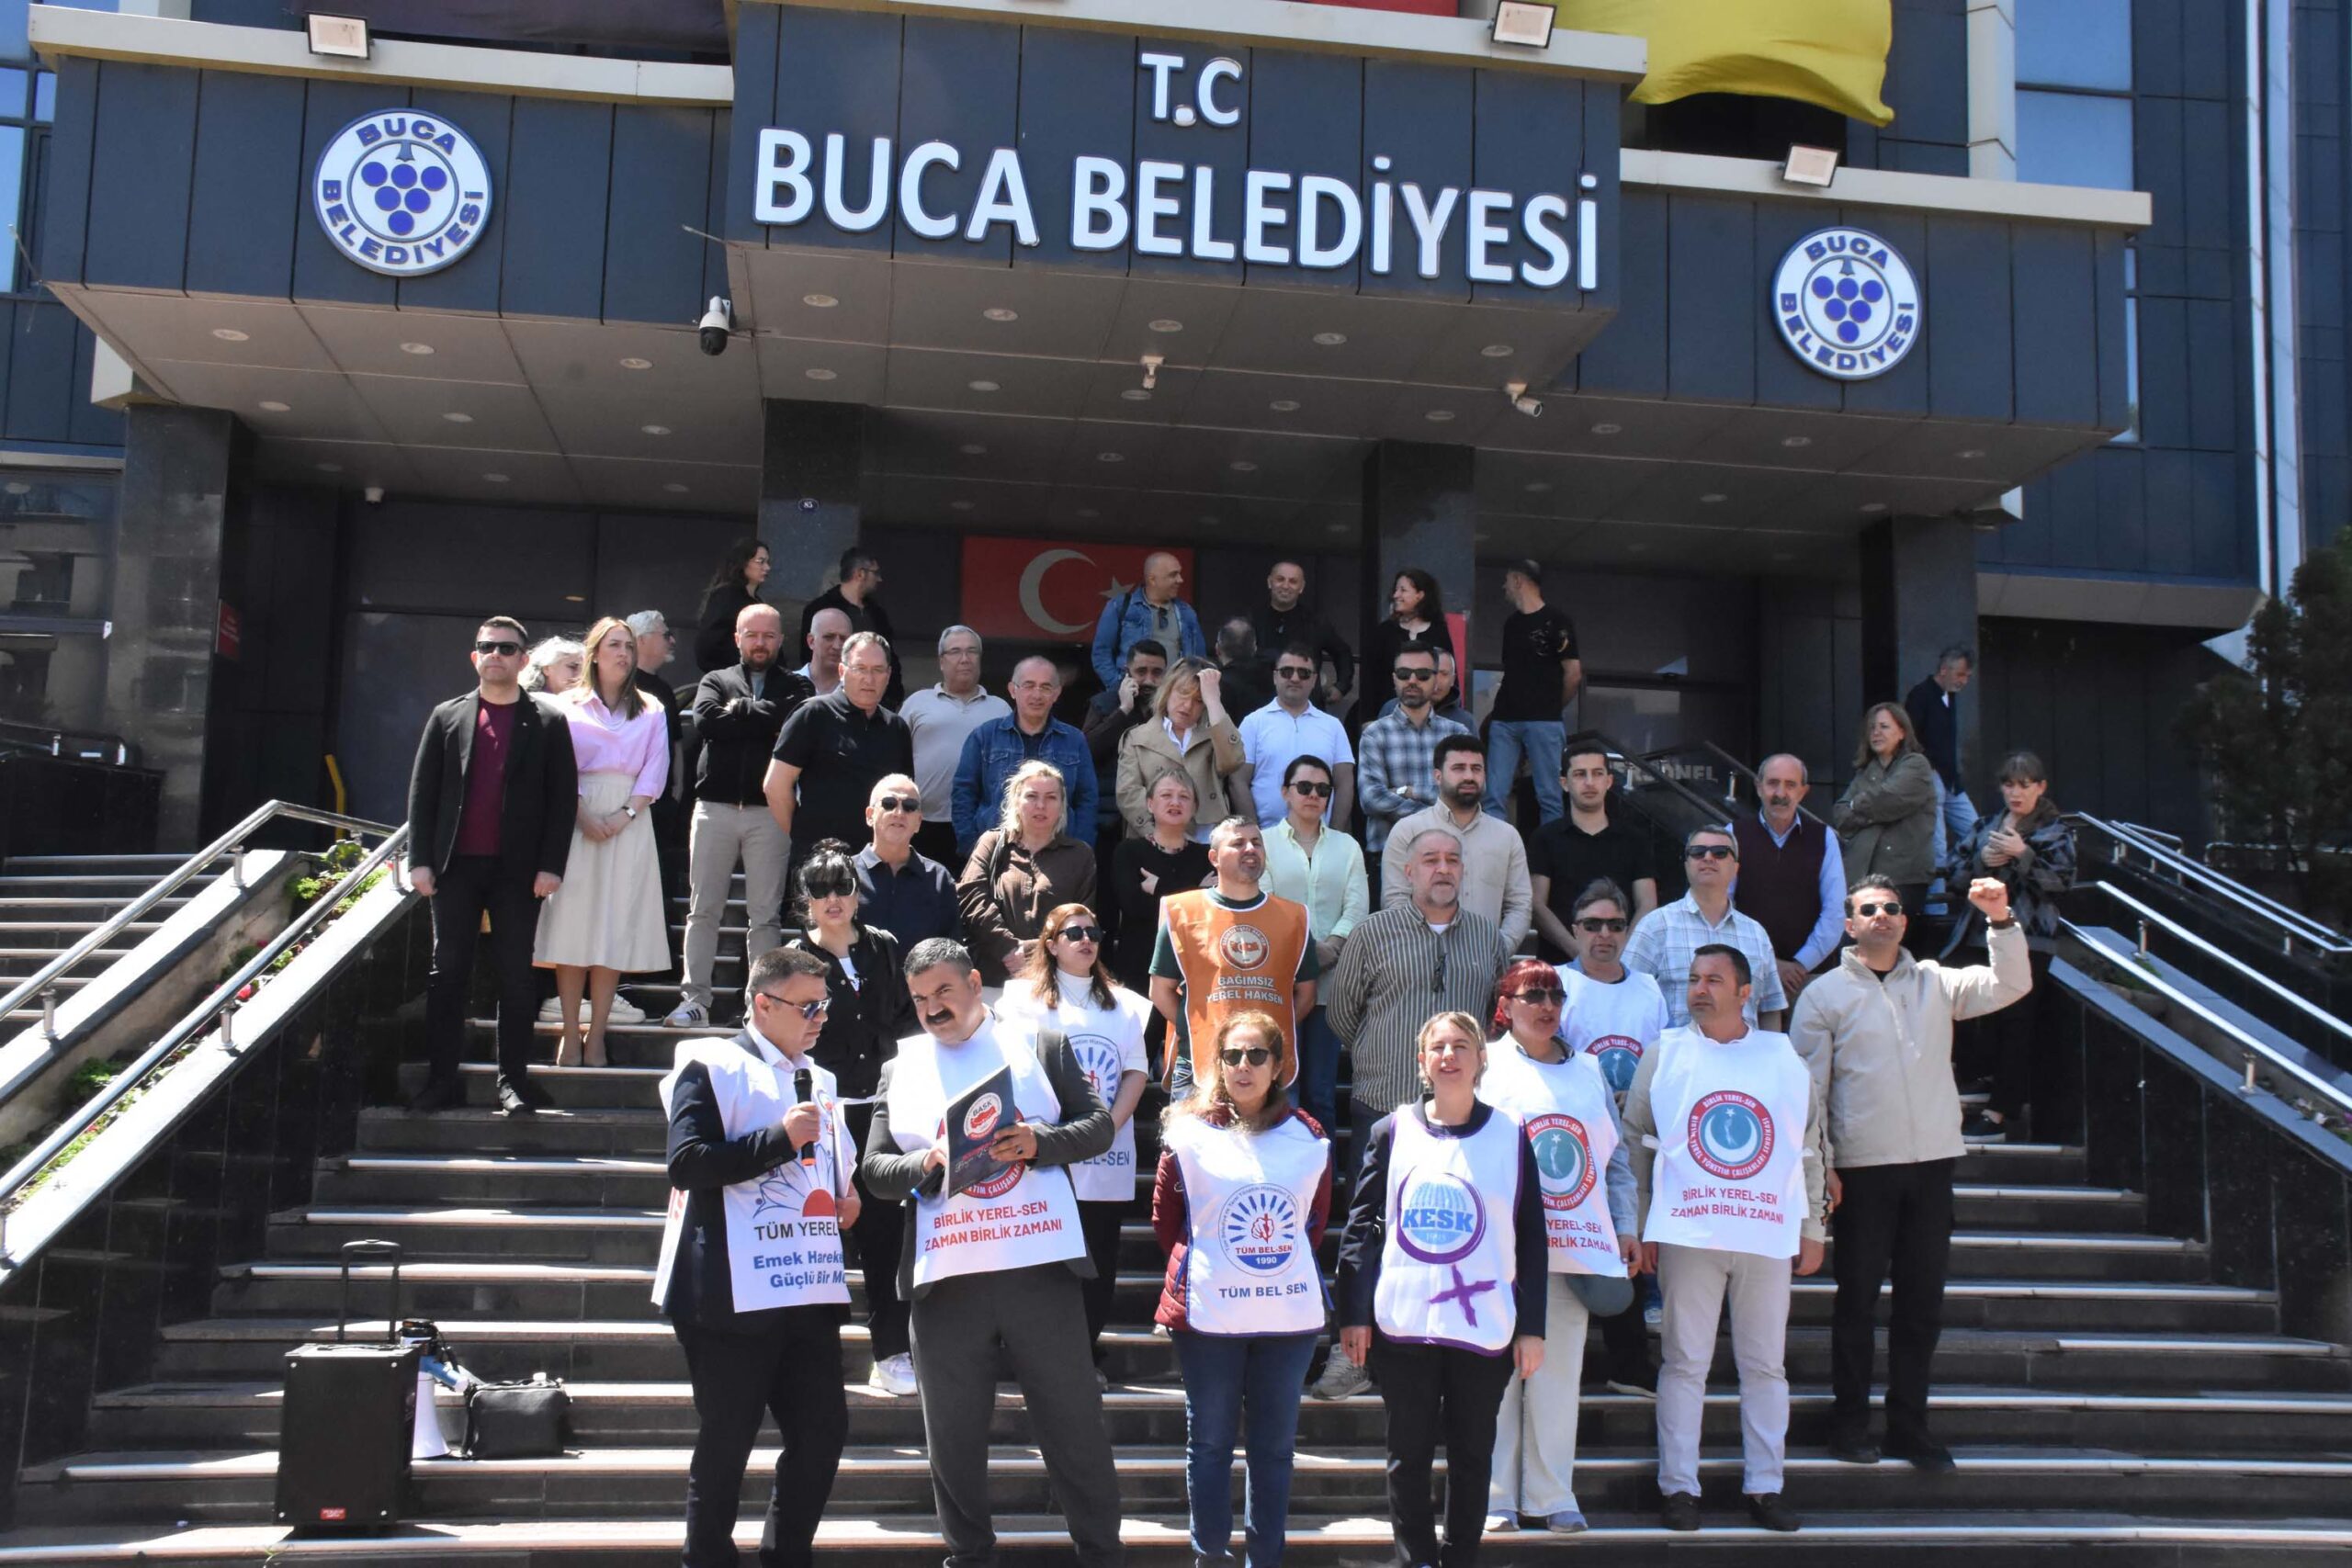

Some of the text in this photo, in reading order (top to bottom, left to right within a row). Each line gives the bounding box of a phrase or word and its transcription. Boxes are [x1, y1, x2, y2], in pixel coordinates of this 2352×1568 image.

[1140, 51, 1245, 129] T.C
[355, 117, 457, 155] BUCA
[752, 125, 1598, 293] BUCA BELEDİYESİ
[1804, 234, 1889, 269] BUCA
[1217, 974, 1274, 987] BAĞIMSIZ
[1206, 989, 1283, 1005] YEREL HAKSEN
[1682, 1185, 1778, 1205] BİRLİK YEREL-SEN
[933, 1201, 1048, 1229] BİRLİK YEREL-SEN
[1402, 1208, 1474, 1233] KESK
[1670, 1201, 1784, 1224] ZAMAN BİRLİK ZAMANI
[754, 1222, 794, 1241] TÜM
[924, 1219, 1062, 1252] ZAMAN BİRLİK ZAMANI
[1547, 1234, 1577, 1248] İRLİK
[753, 1252, 803, 1269] Emek
[1235, 1246, 1256, 1255] TÜM
[1255, 1257, 1277, 1265] 1990
[770, 1271, 815, 1290] Güçlü
[817, 1270, 830, 1285] Bir
[1219, 1282, 1307, 1298] TÜM BEL SEN
